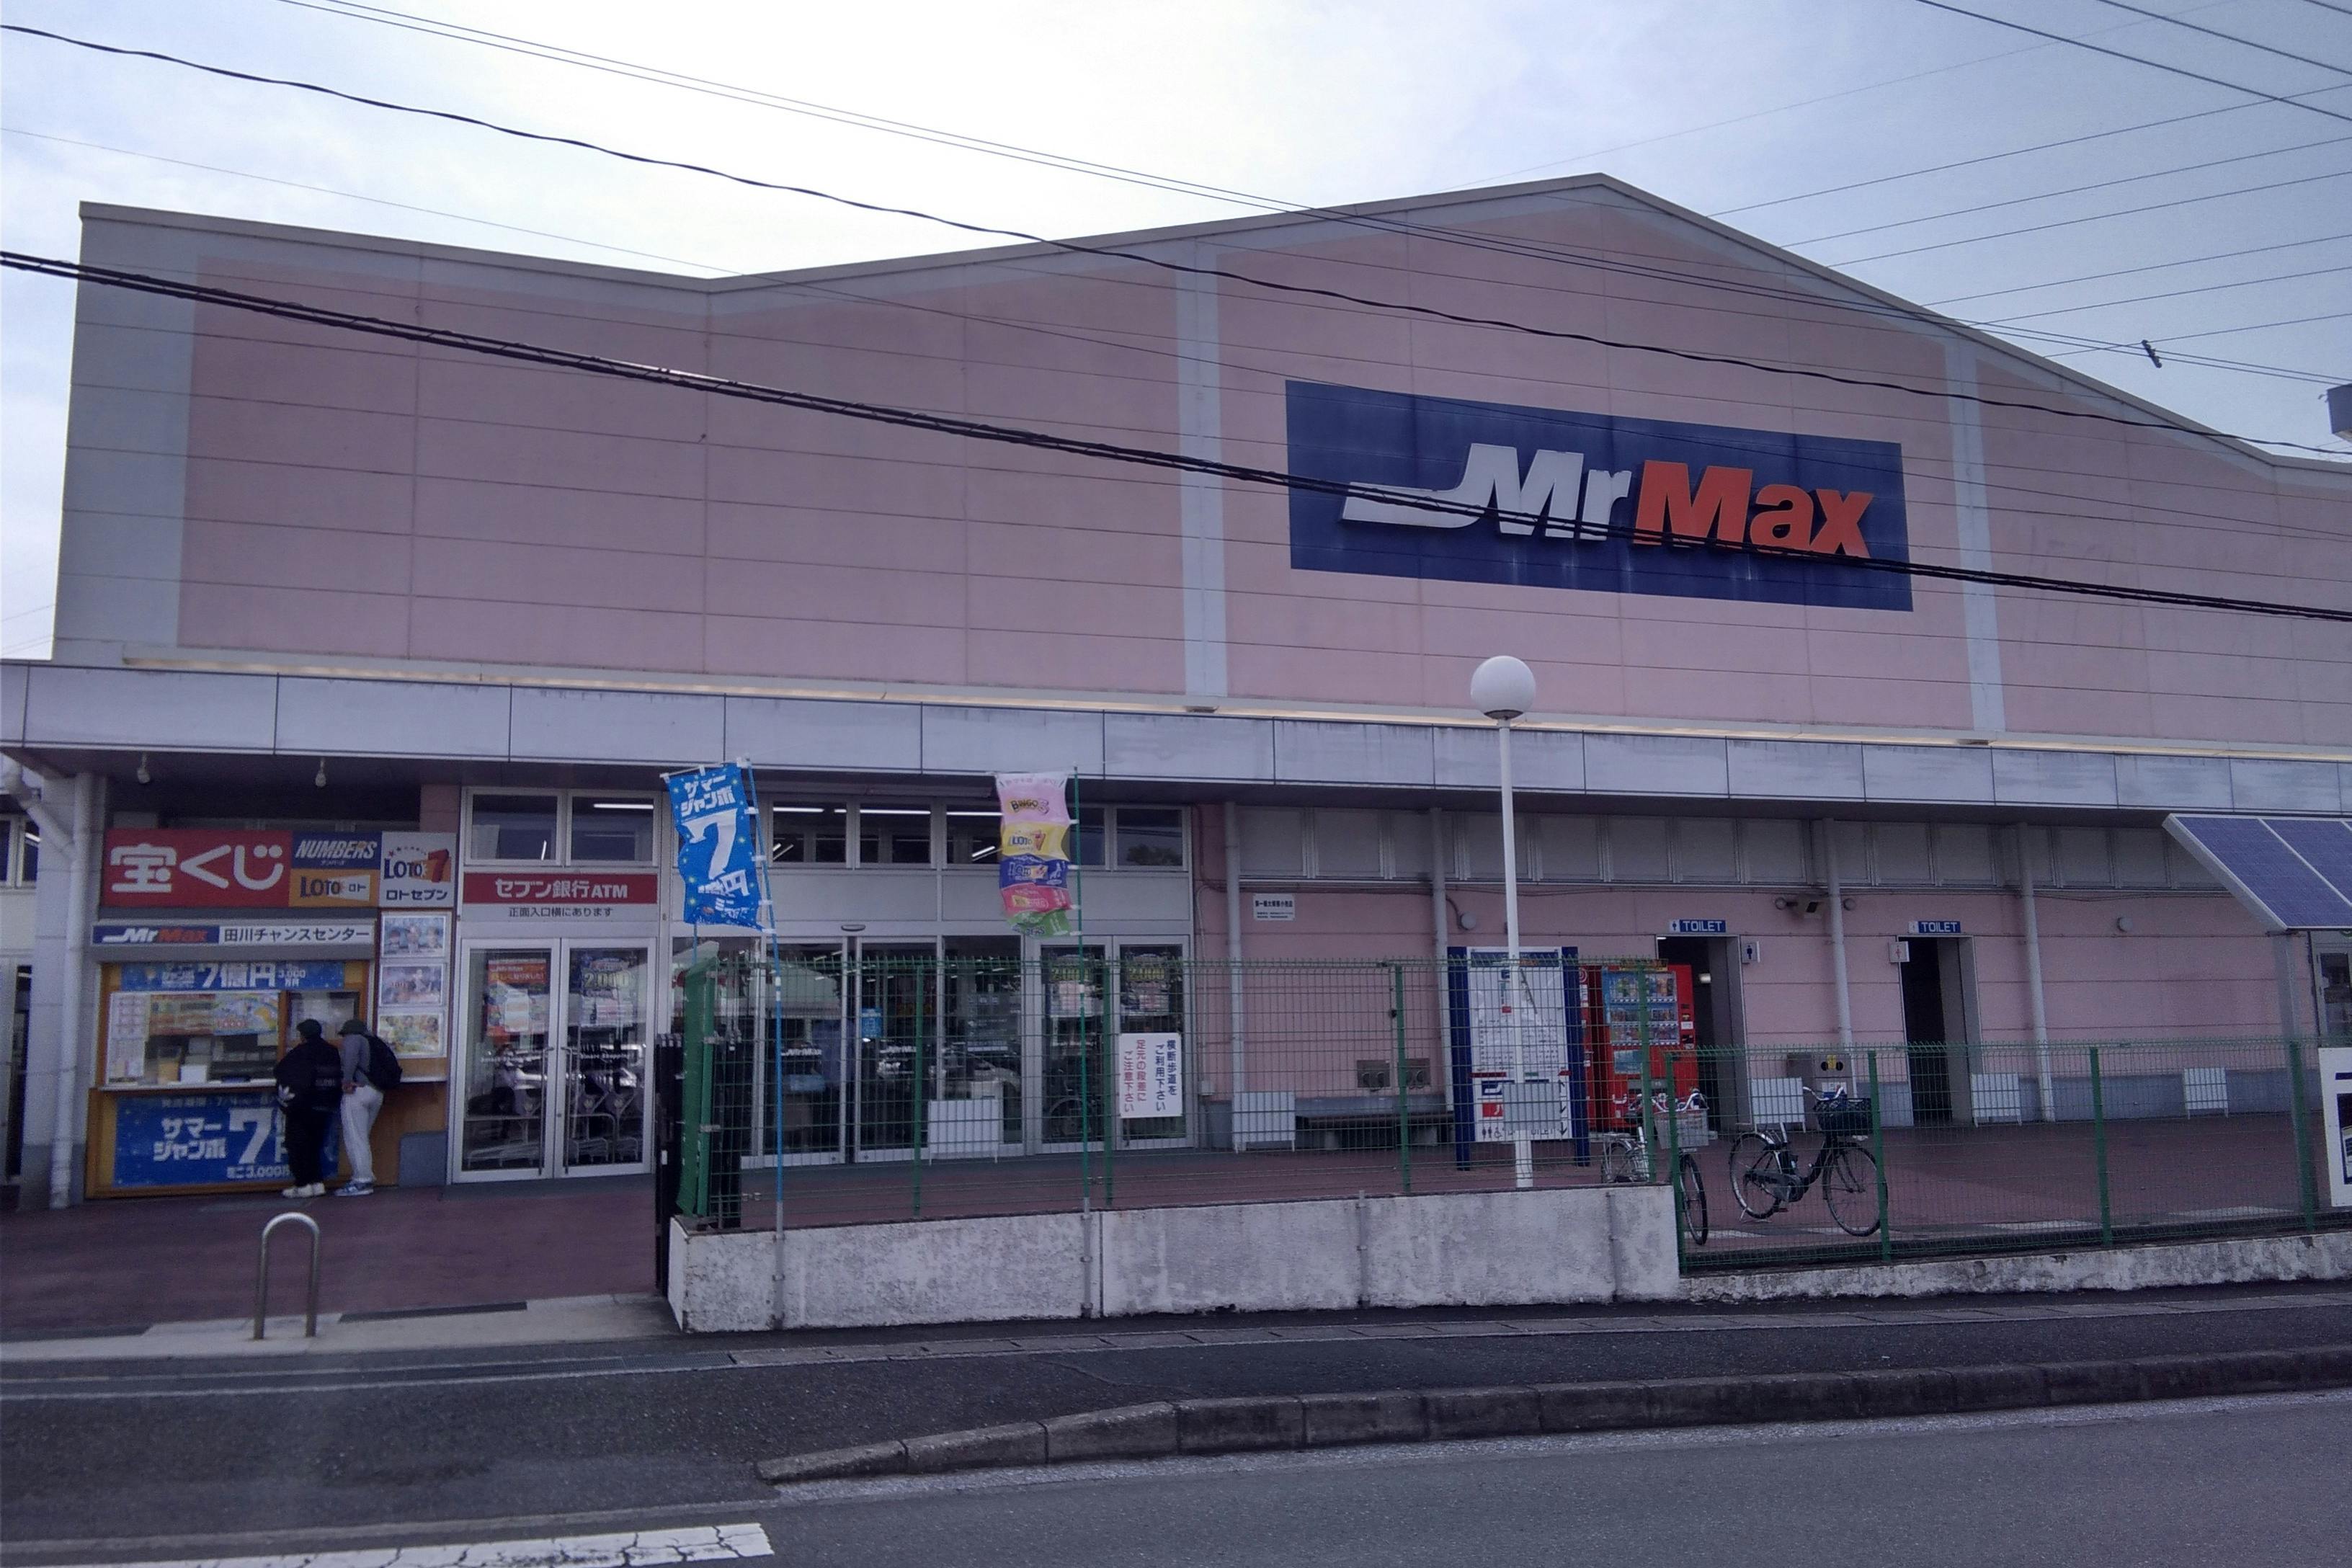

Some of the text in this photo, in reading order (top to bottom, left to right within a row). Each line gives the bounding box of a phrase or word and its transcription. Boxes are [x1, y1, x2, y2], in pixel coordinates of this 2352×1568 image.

[1342, 442, 1872, 559] MrMax
[684, 775, 726, 798] サマー
[681, 785, 736, 817] ジャンボ
[295, 839, 378, 860] NUMBERS
[110, 843, 284, 893] 宝くじ
[386, 889, 448, 901] ロトセブン
[509, 906, 613, 917] 正面入口横にあります
[102, 927, 208, 943] MrMax
[224, 927, 370, 942] 田川チャンスセンター
[1682, 920, 1722, 932] TOILET
[1921, 922, 1958, 932] TOILET
[1136, 1039, 1147, 1102] 足元の段差に
[1155, 1043, 1166, 1112] ご利用下さい
[1167, 1039, 1177, 1095] 横断歩道を
[1124, 1050, 1135, 1113] ご注意下さい
[161, 1118, 221, 1139] サマー
[153, 1138, 227, 1162] ジャンボ
